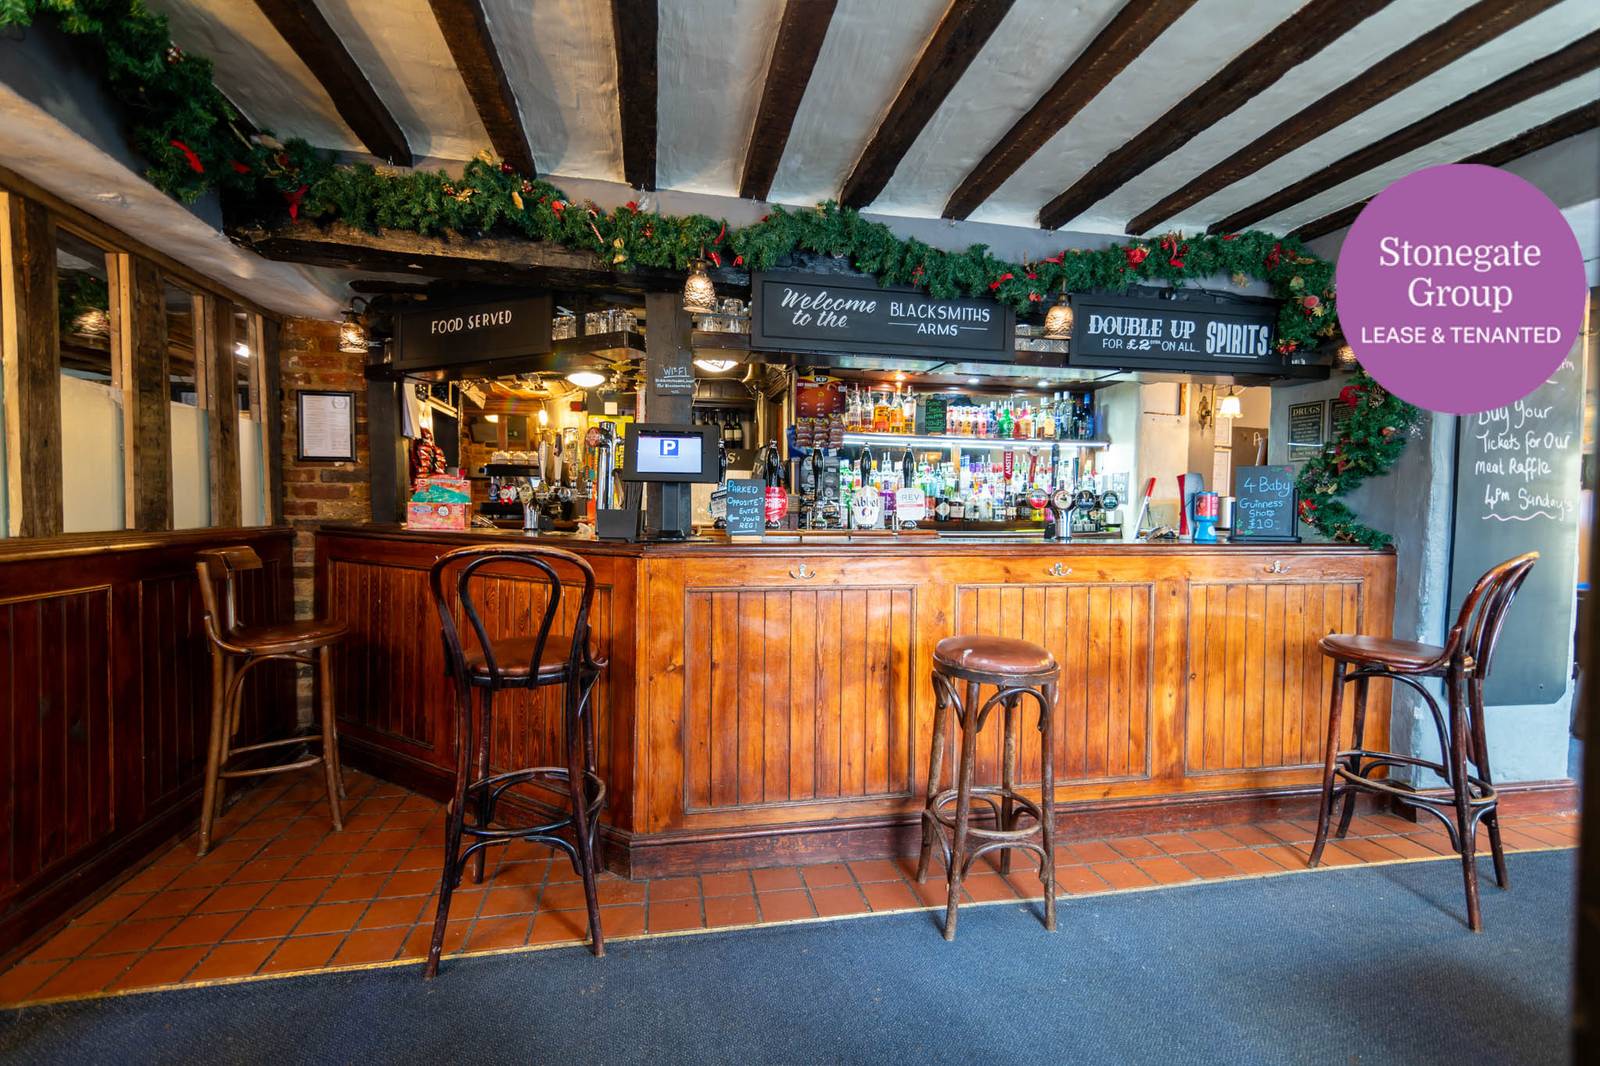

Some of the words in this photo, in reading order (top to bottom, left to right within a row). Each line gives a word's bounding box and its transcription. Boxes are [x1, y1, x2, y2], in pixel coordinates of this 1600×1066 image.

[781, 288, 877, 314] Welcome
[792, 309, 812, 326] to
[817, 311, 848, 328] the
[890, 302, 990, 322] BLACKSMITHS
[431, 317, 463, 334] FOOD
[467, 310, 512, 330] SERVED
[917, 323, 958, 336] ARMS
[1088, 315, 1162, 337] DOUBLE
[1171, 319, 1196, 339] UP
[1102, 338, 1123, 349] FOR
[1126, 338, 1151, 350] £2
[1161, 341, 1176, 351] ON
[1177, 342, 1194, 353] ALL
[1292, 406, 1321, 416] DRUGS
[1476, 430, 1520, 453] Tickets
[1544, 431, 1572, 449] Our
[1509, 457, 1551, 483] Raffle
[727, 480, 758, 494] PARKED
[1244, 477, 1256, 493] 4
[1259, 476, 1290, 497] Baby
[727, 496, 764, 507] OPPOSITE?
[739, 507, 759, 515] ENTER
[1240, 497, 1284, 509] Guinness
